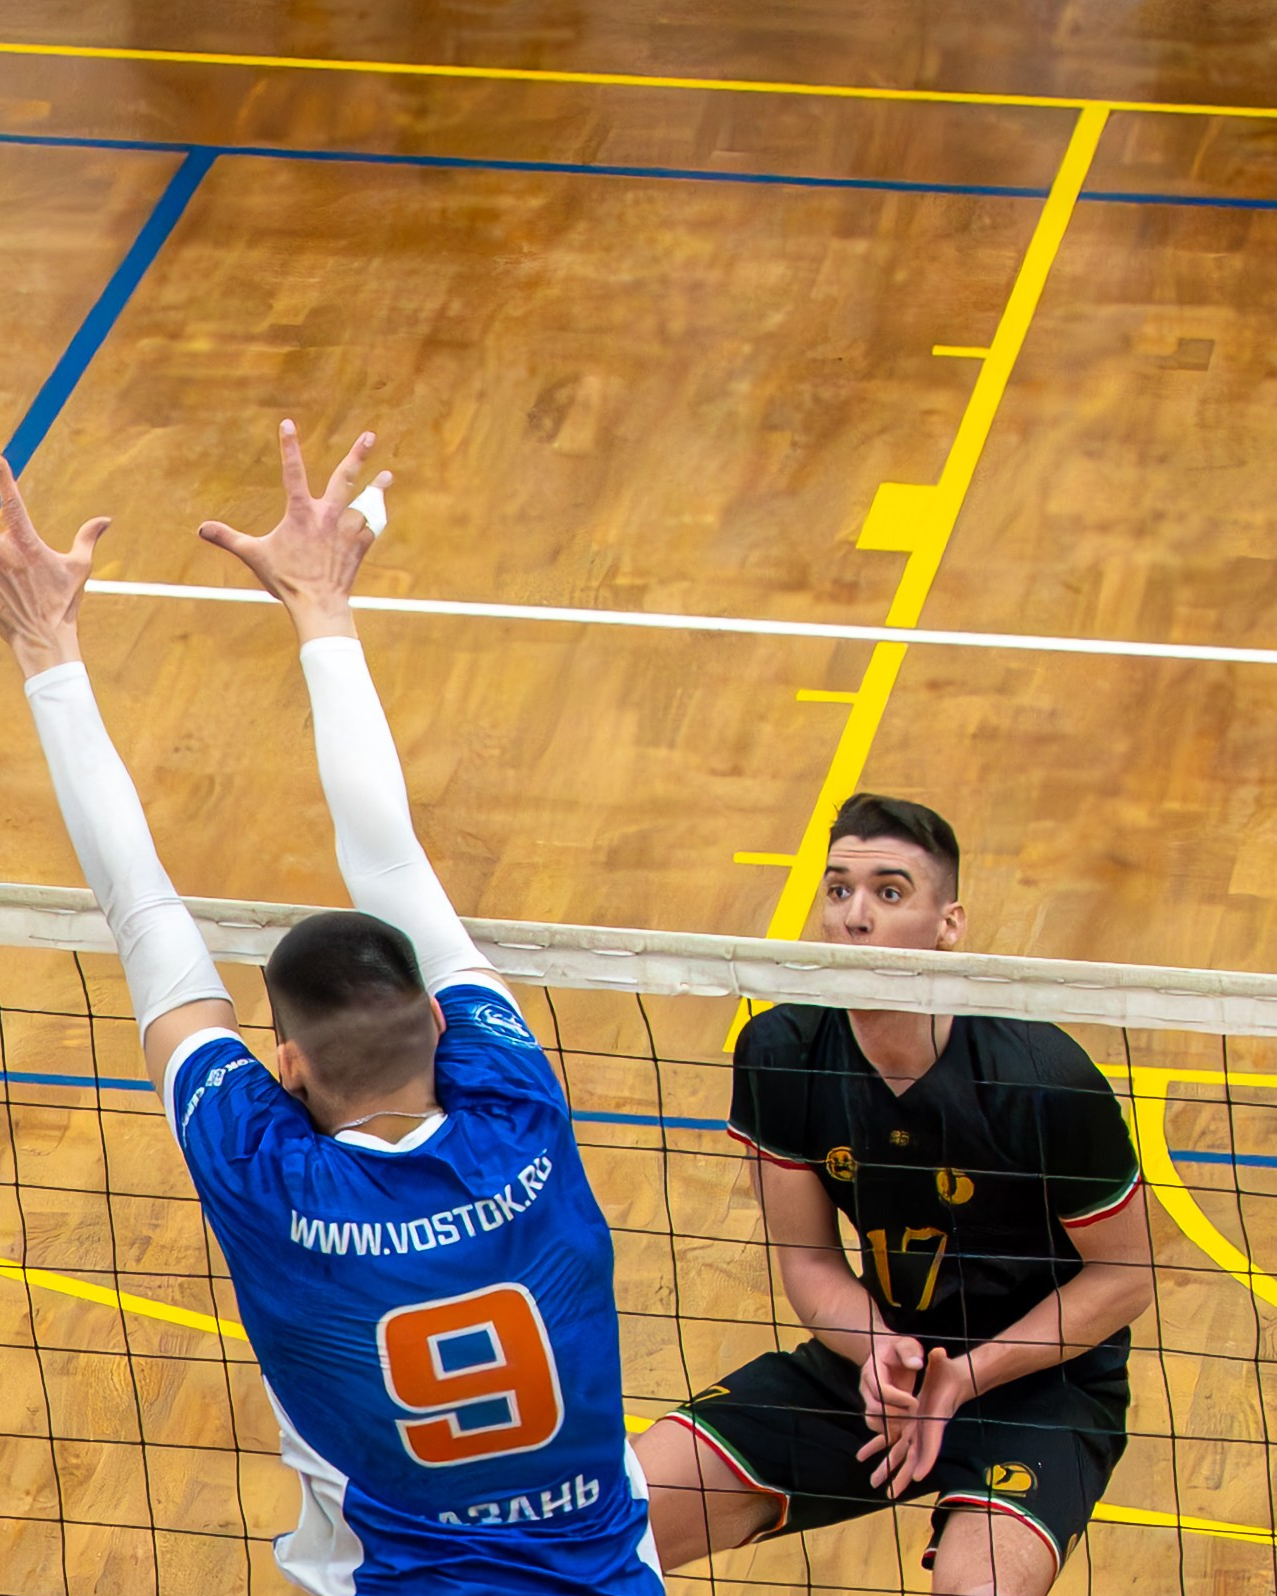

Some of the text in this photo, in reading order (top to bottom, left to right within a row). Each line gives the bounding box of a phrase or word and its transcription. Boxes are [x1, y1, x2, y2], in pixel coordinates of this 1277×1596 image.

[291, 1149, 553, 1256] WWW.VOSTOK.RU
[866, 1226, 948, 1311] 17
[376, 1282, 565, 1468] 9
